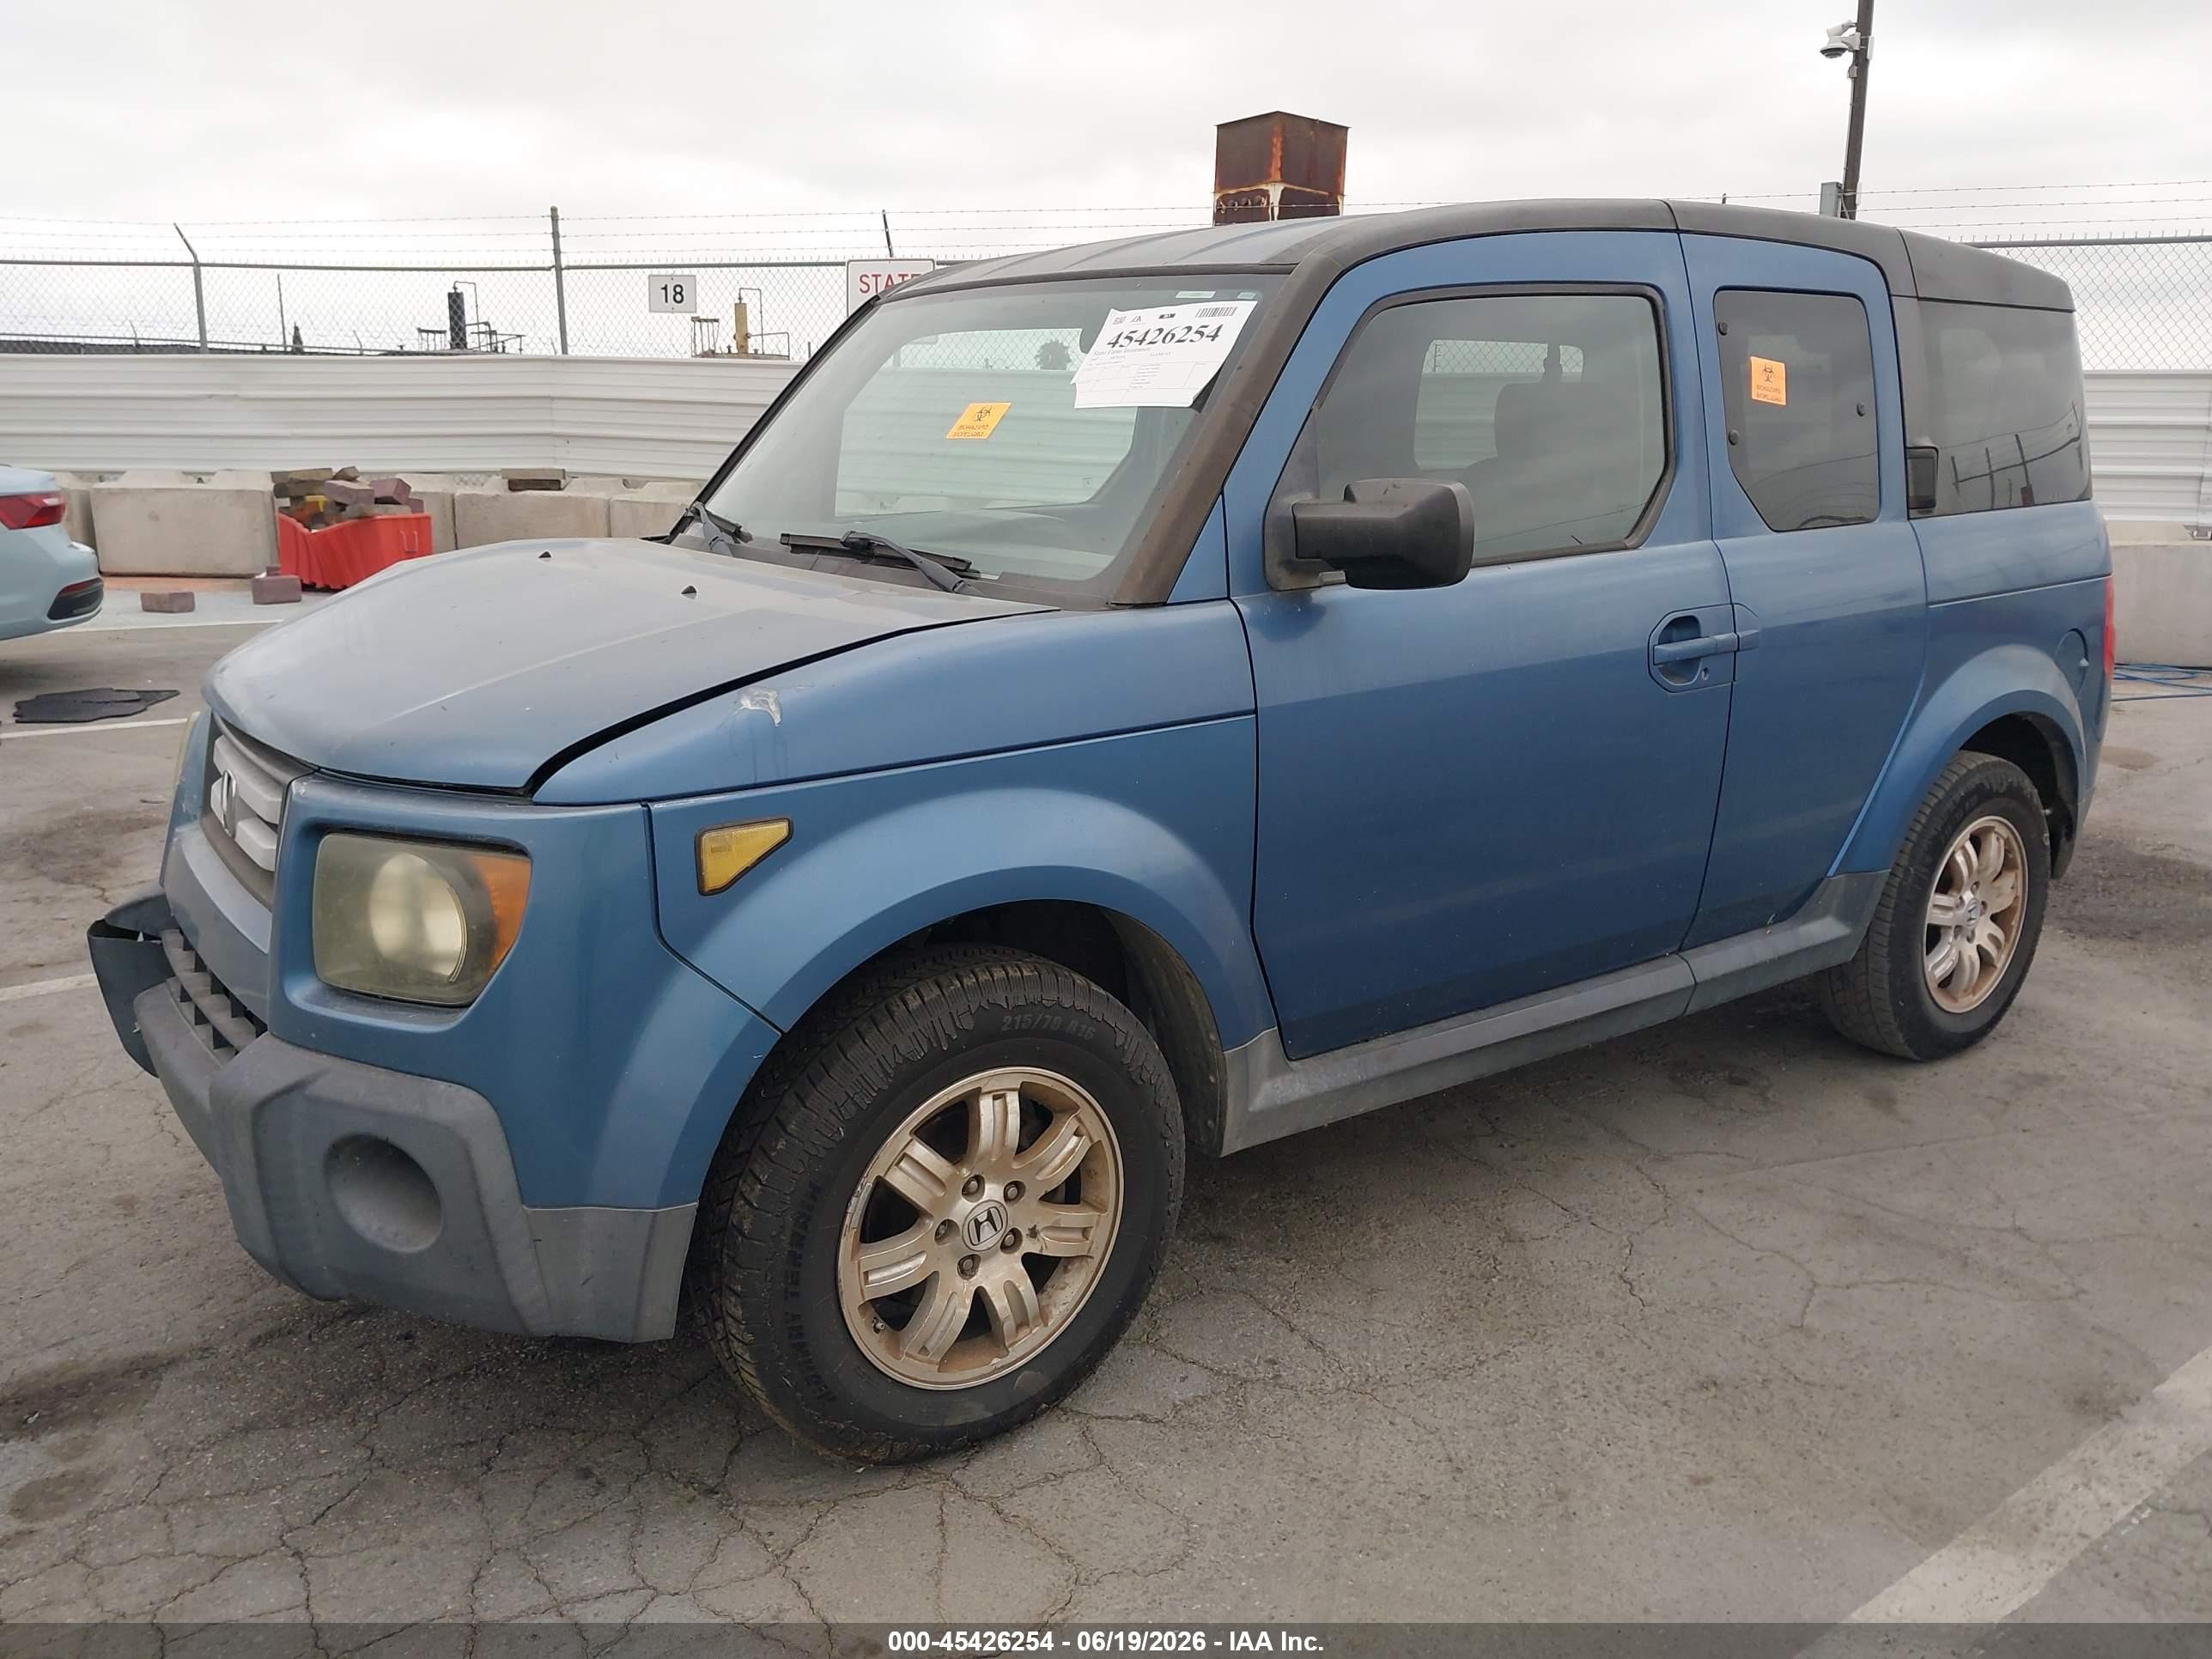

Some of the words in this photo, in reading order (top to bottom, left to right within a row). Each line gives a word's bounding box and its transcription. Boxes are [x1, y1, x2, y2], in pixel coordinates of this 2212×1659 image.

[659, 283, 684, 304] 18
[859, 273, 921, 295] STAT
[1107, 324, 1224, 348] 45426254
[1001, 1013, 1062, 1031] 215/70
[1066, 1019, 1097, 1041] R16
